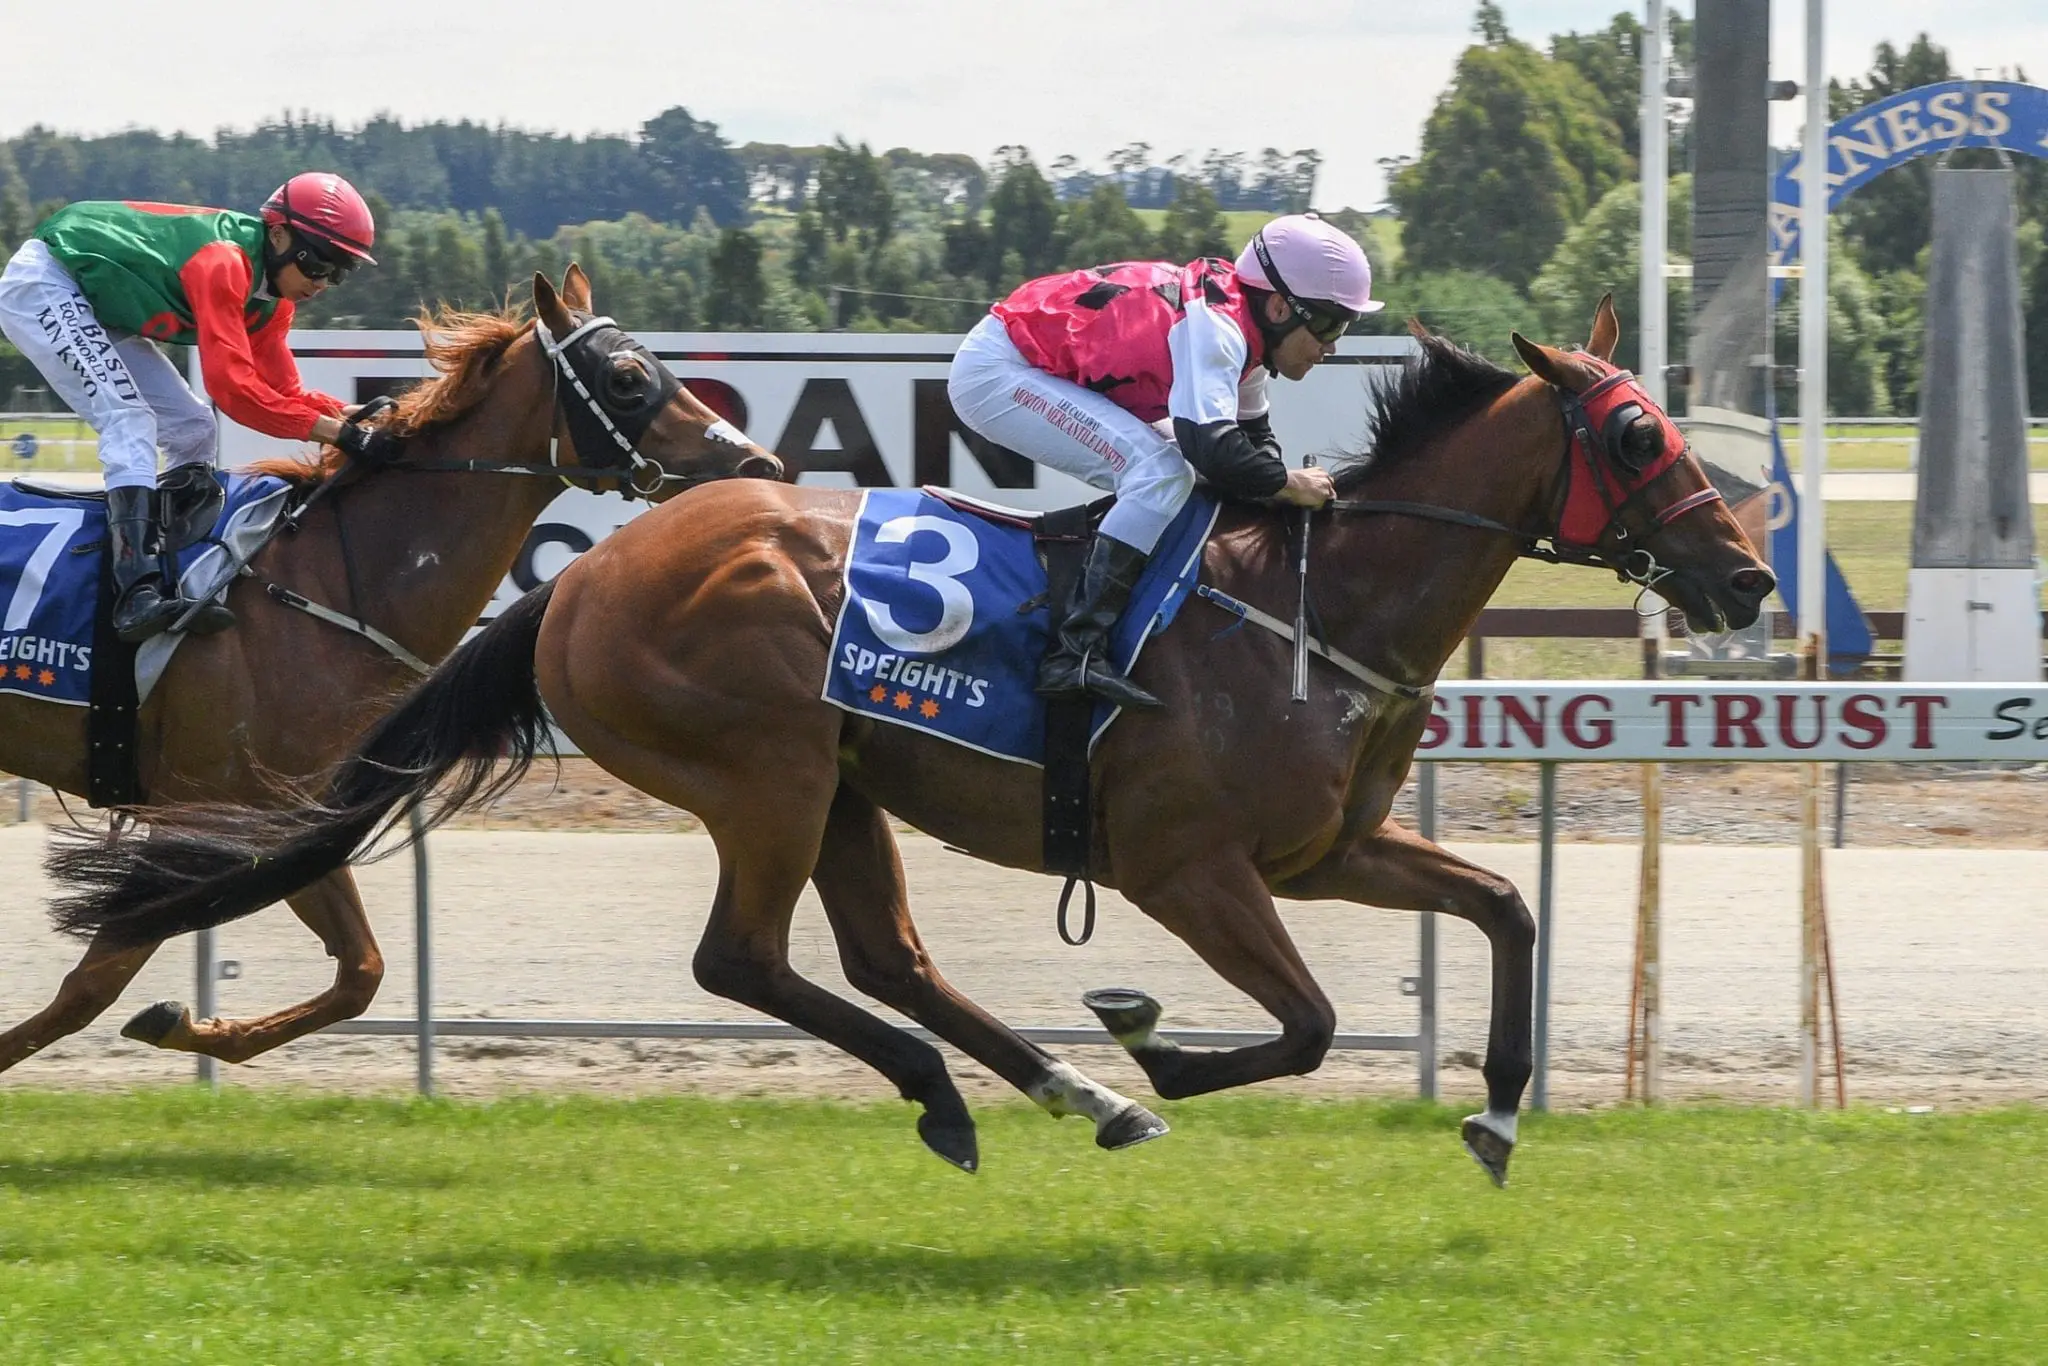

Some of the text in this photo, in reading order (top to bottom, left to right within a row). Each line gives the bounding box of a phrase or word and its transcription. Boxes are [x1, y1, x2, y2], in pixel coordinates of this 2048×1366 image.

[36, 306, 65, 344] KIN
[1013, 387, 1049, 415] MORTON
[1045, 405, 1099, 448] MERCANTILE
[0, 508, 85, 631] 7
[860, 515, 979, 653] 3
[840, 642, 989, 708] SPEIGHT'S
[1417, 694, 1616, 750] SING
[1651, 694, 1949, 750] TRUST
